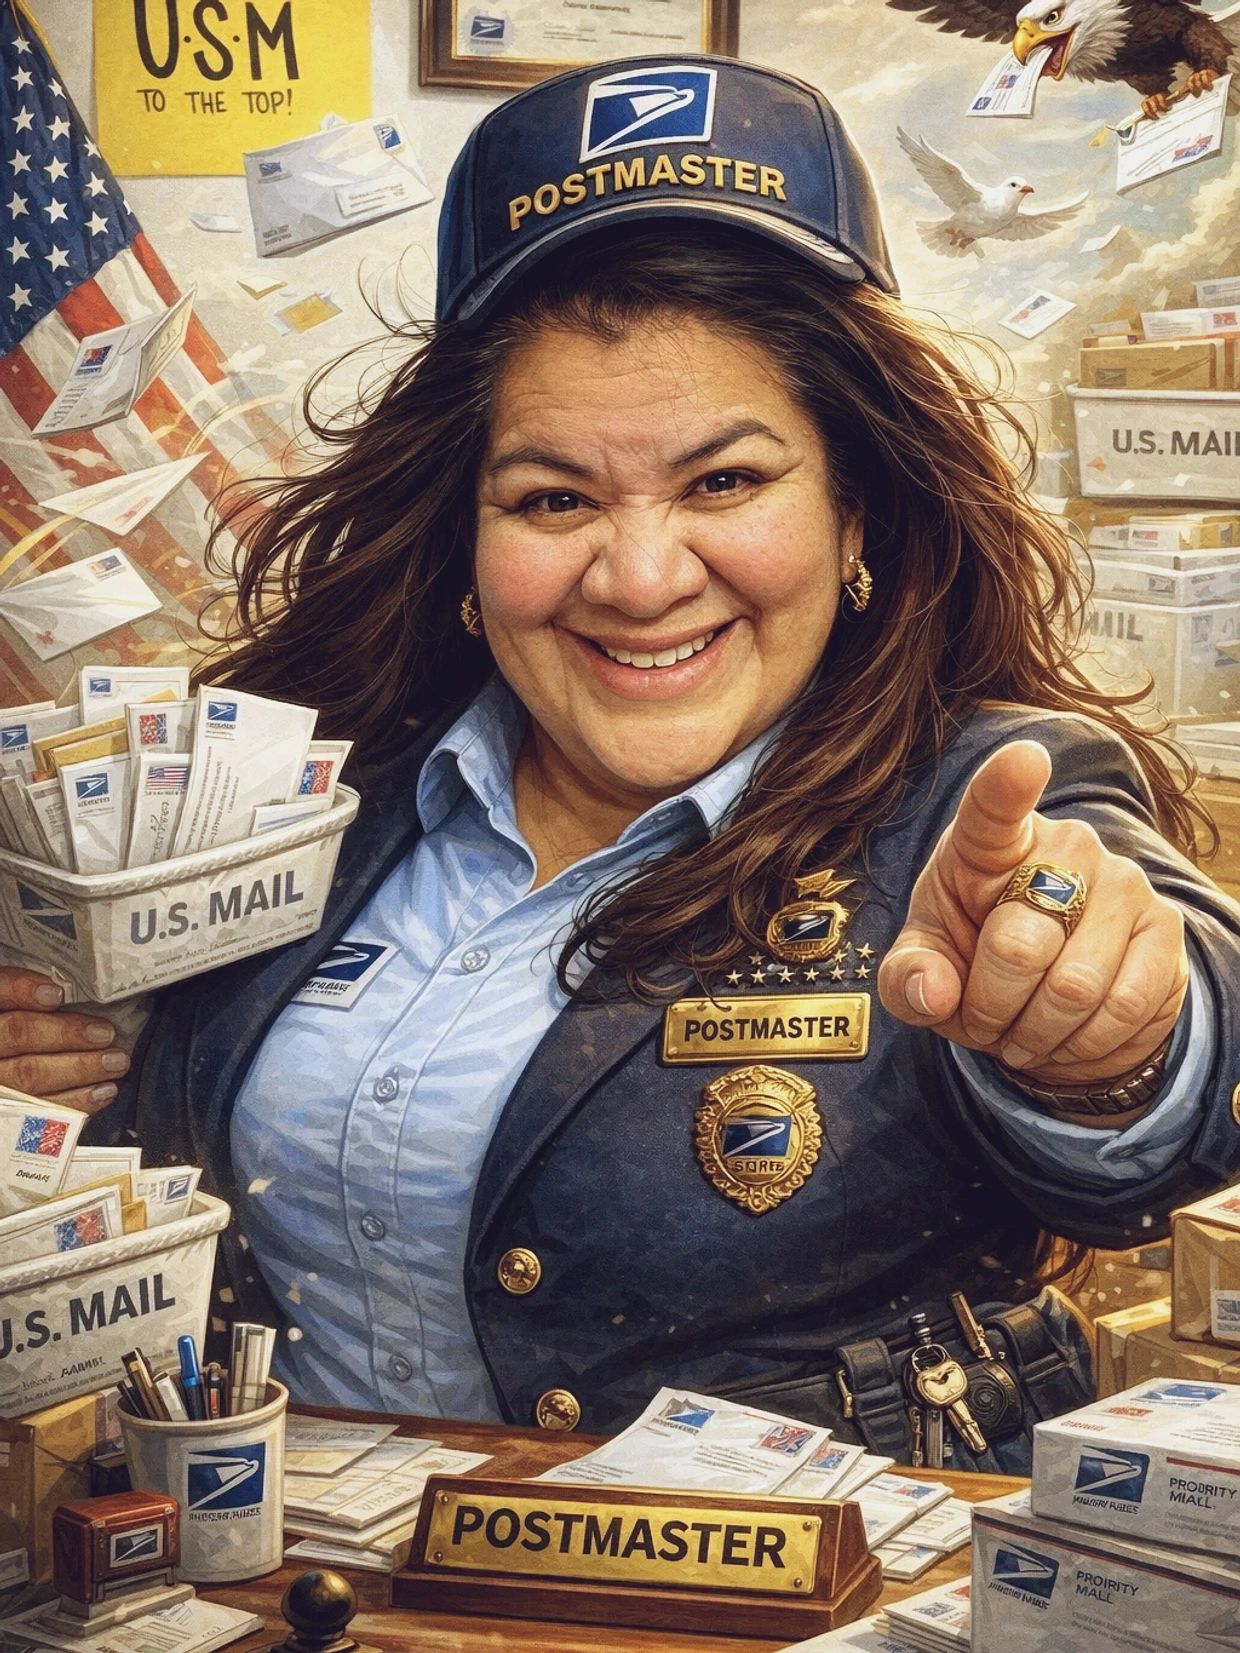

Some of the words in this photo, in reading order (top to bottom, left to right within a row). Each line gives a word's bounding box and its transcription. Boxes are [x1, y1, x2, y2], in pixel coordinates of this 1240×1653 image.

[137, 89, 166, 113] TO
[185, 91, 226, 114] THE
[242, 90, 293, 115] TOP!
[508, 154, 788, 232] POSTMASTER
[1112, 429, 1164, 455] U.S.
[130, 901, 199, 945] U.S.
[208, 870, 304, 926] MAIL
[684, 1016, 849, 1042] POSTMASTER
[69, 1272, 177, 1336] MAIL
[451, 1505, 786, 1569] POSTMASTER
